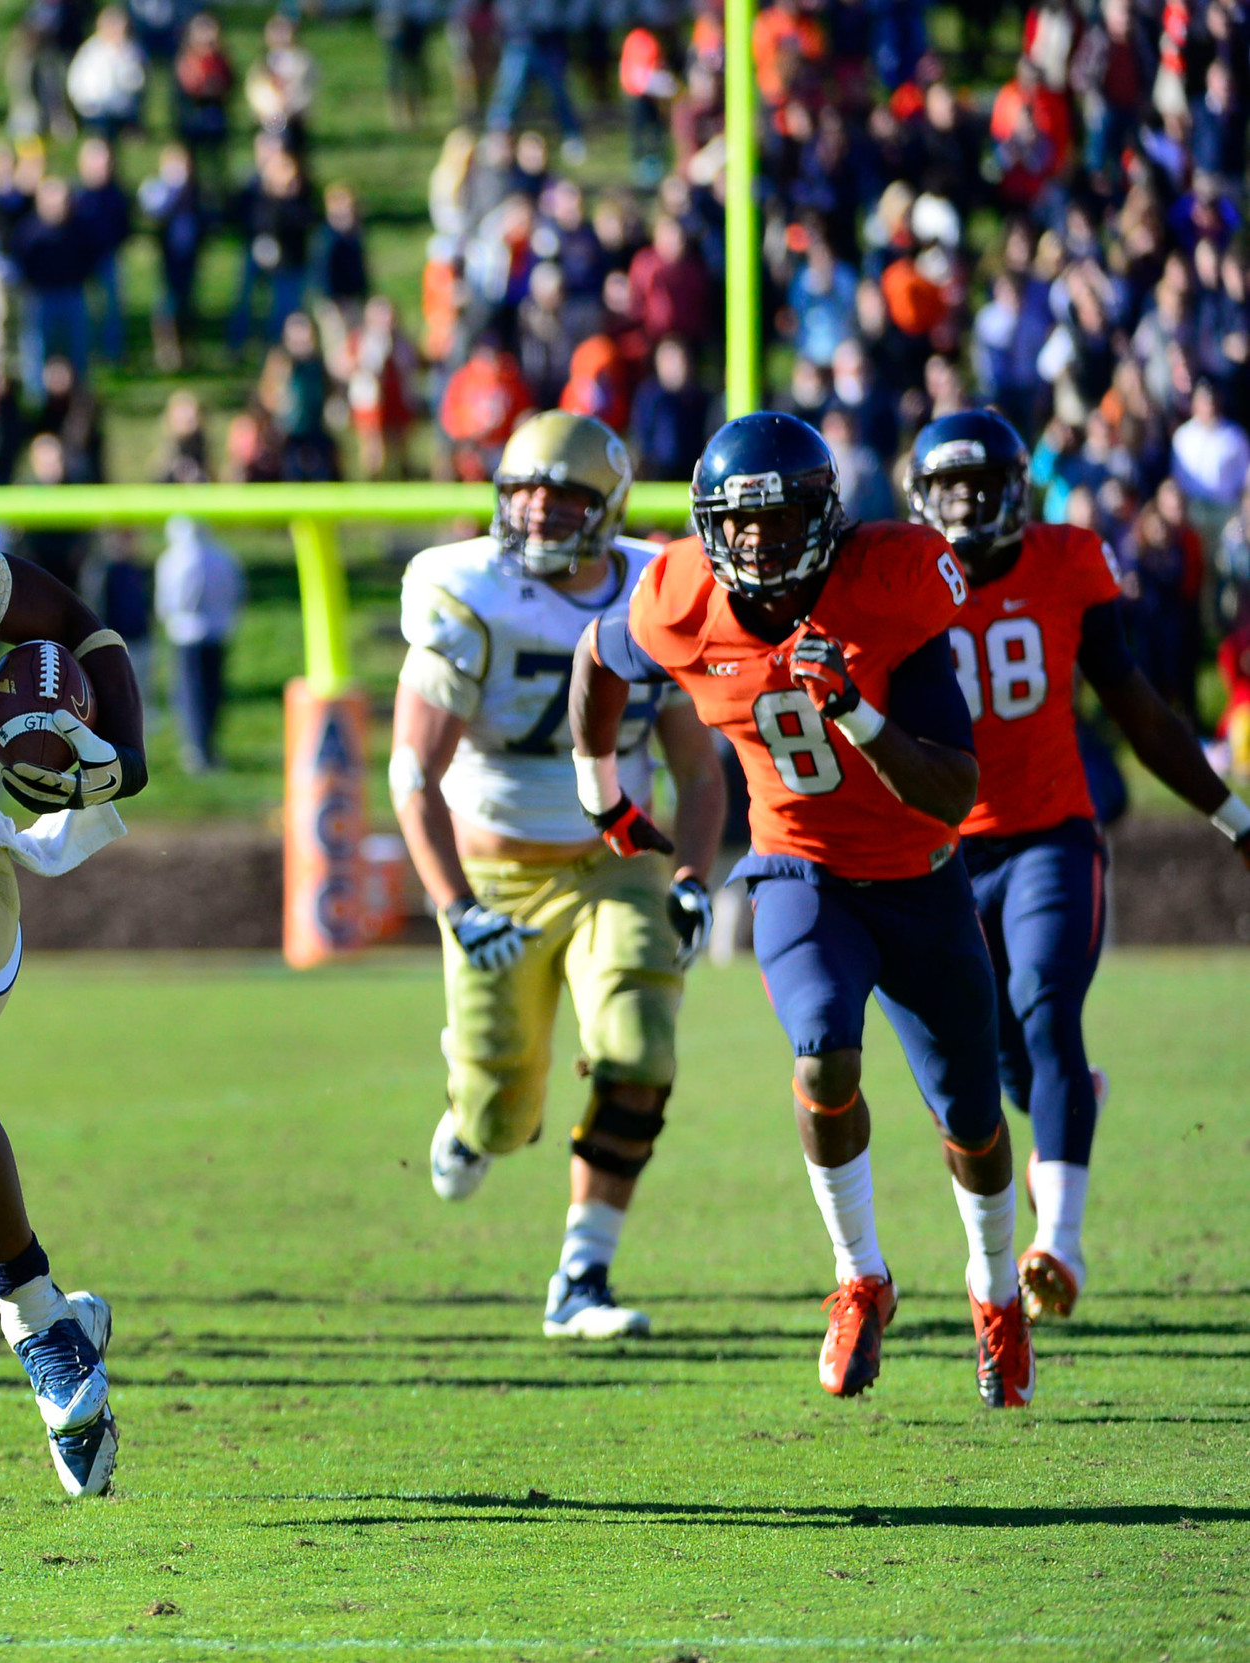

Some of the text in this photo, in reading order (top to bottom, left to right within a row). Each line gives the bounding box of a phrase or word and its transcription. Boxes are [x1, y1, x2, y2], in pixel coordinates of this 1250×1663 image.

[741, 479, 765, 489] ACC
[937, 551, 967, 606] 8
[706, 661, 740, 677] ACC
[25, 715, 47, 730] GT
[751, 688, 845, 797] 8
[313, 706, 358, 951] ACC
